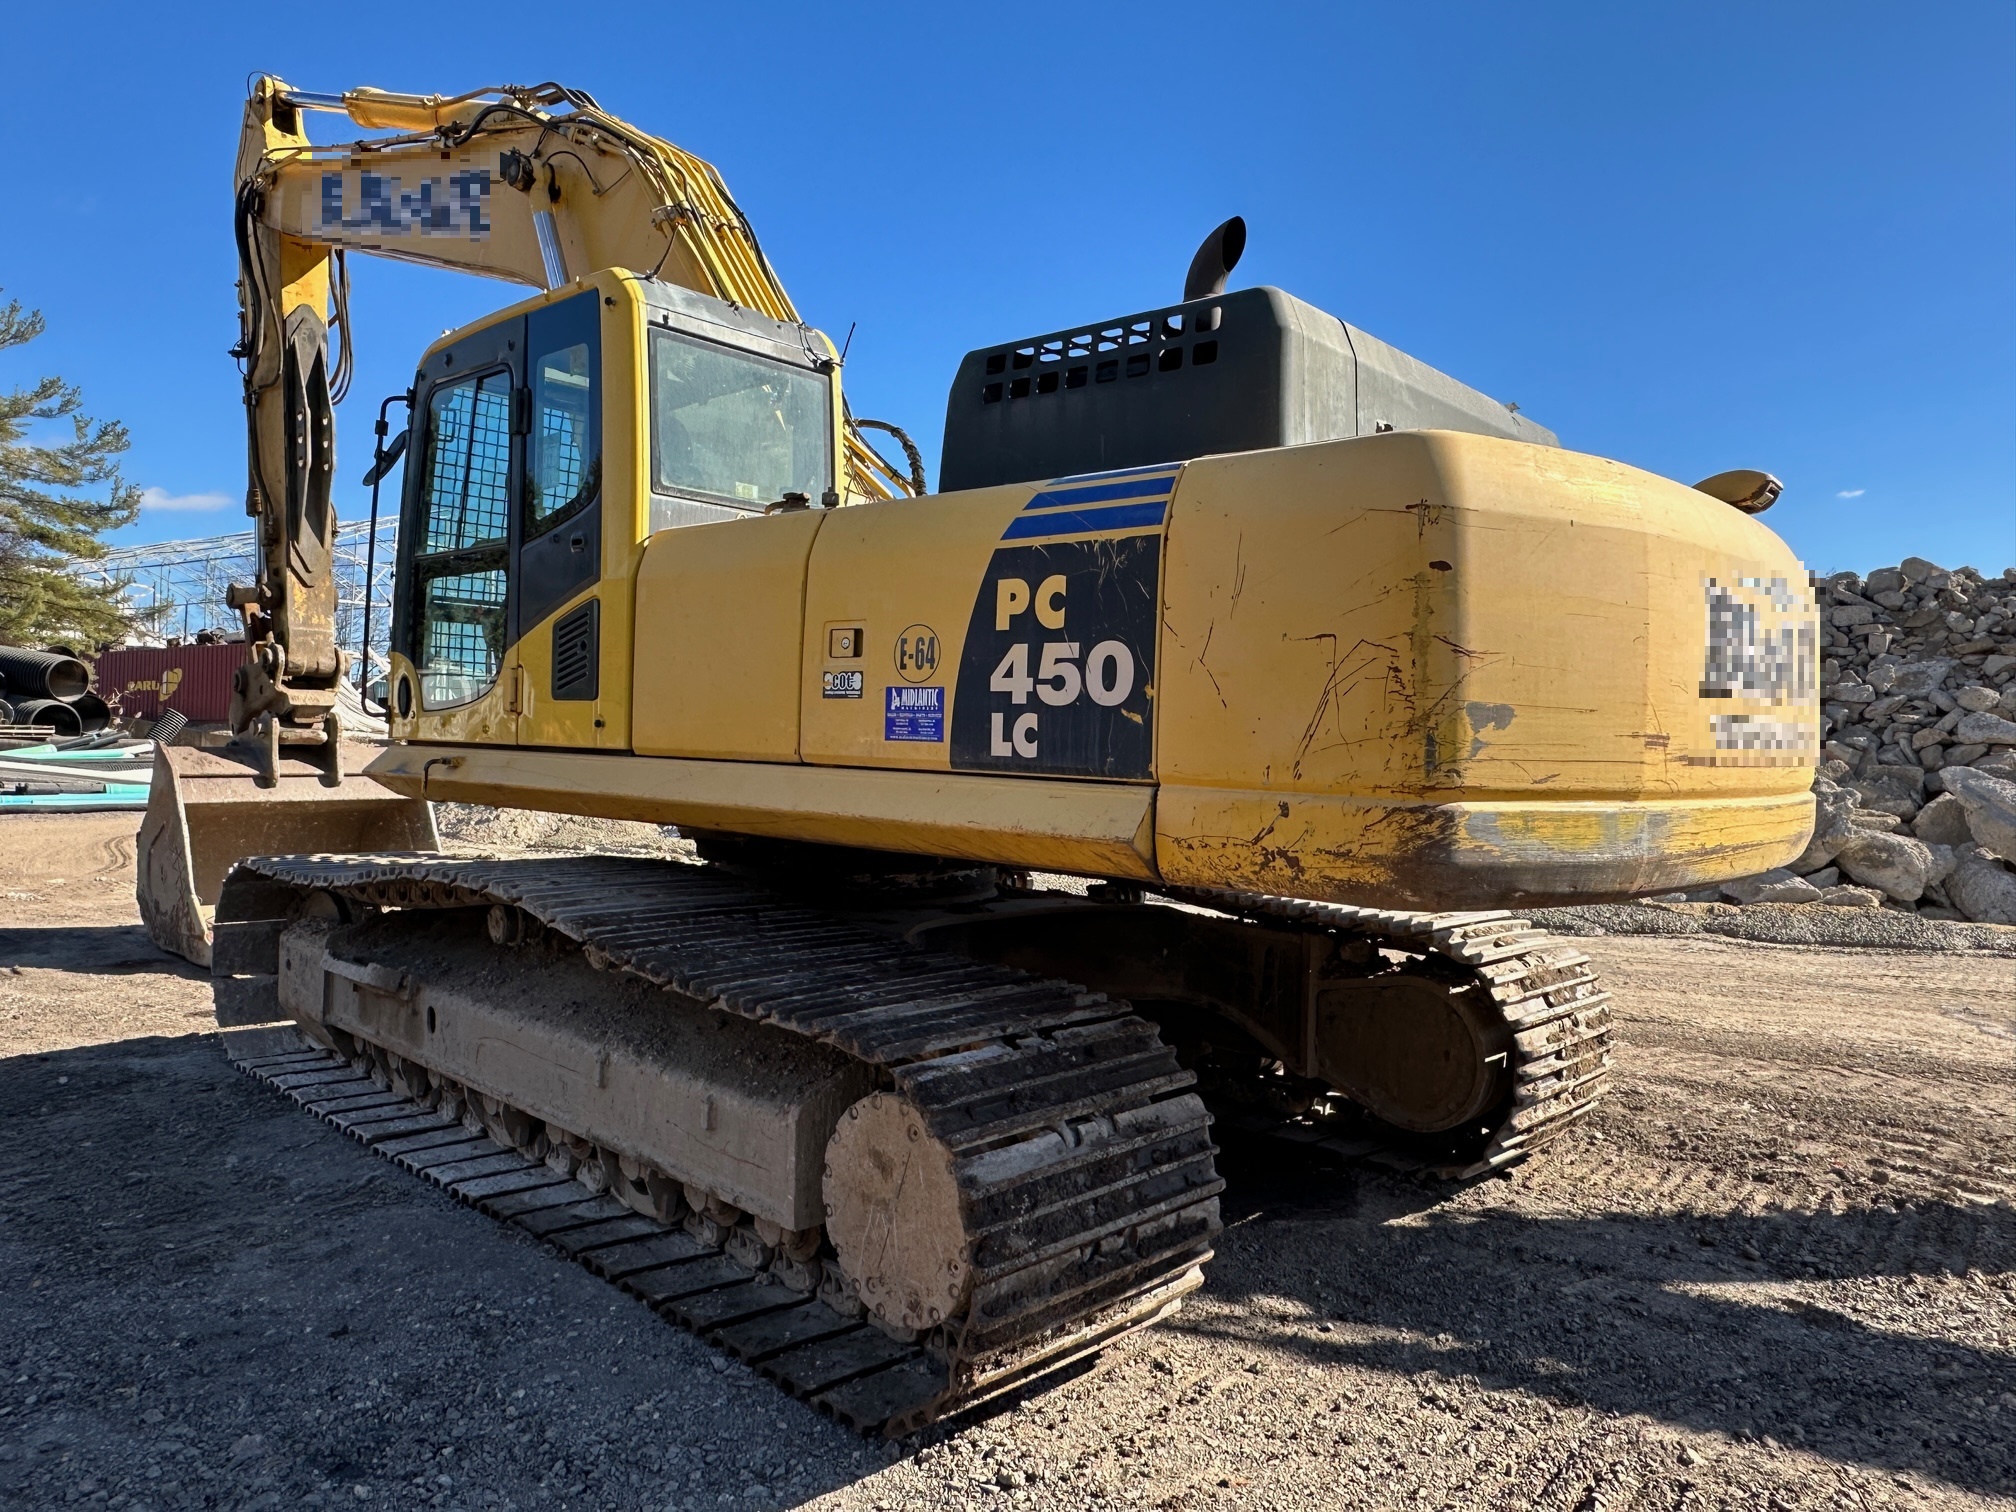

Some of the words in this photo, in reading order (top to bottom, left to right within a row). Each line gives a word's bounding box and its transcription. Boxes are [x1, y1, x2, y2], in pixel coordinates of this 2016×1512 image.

[995, 574, 1067, 631] PC
[899, 636, 936, 671] E-64
[990, 640, 1135, 706] 450
[900, 688, 939, 706] MIDLANTIC
[990, 712, 1038, 759] LC
